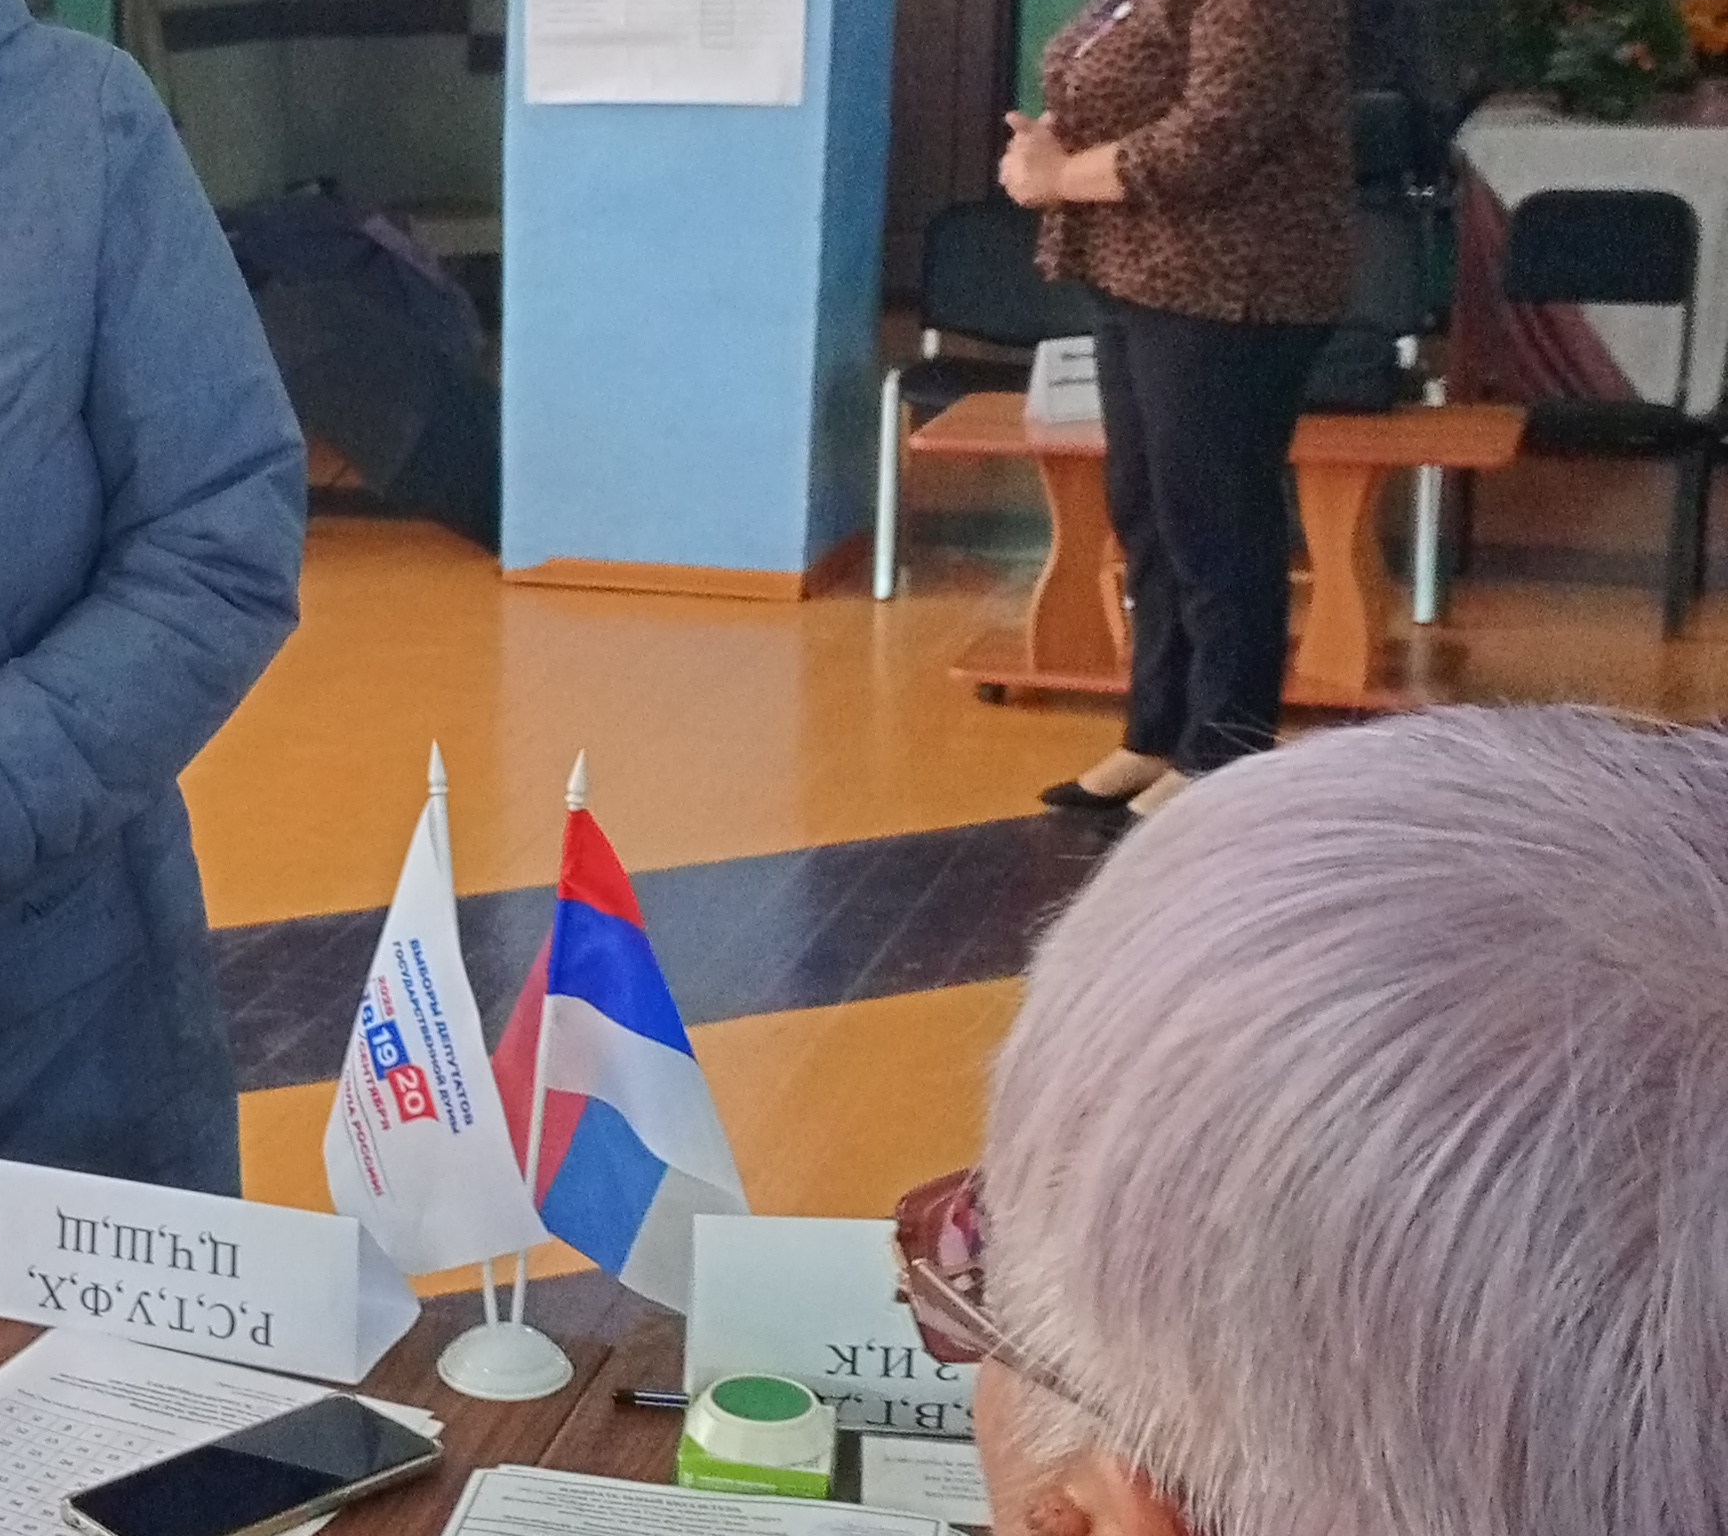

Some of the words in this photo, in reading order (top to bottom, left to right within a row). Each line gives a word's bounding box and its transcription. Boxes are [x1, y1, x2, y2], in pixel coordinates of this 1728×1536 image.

[357, 1041, 390, 1131] СЕНТЯБРЯ
[372, 1030, 399, 1067] 19
[395, 1070, 425, 1115] 20
[392, 941, 445, 1088] ГОСУДАРСТВЕННОЙ
[438, 1086, 460, 1135] ДУМЫ
[409, 938, 443, 1016] ВЫБОРЫ
[435, 1020, 474, 1126] ДЕПУТАТОВ
